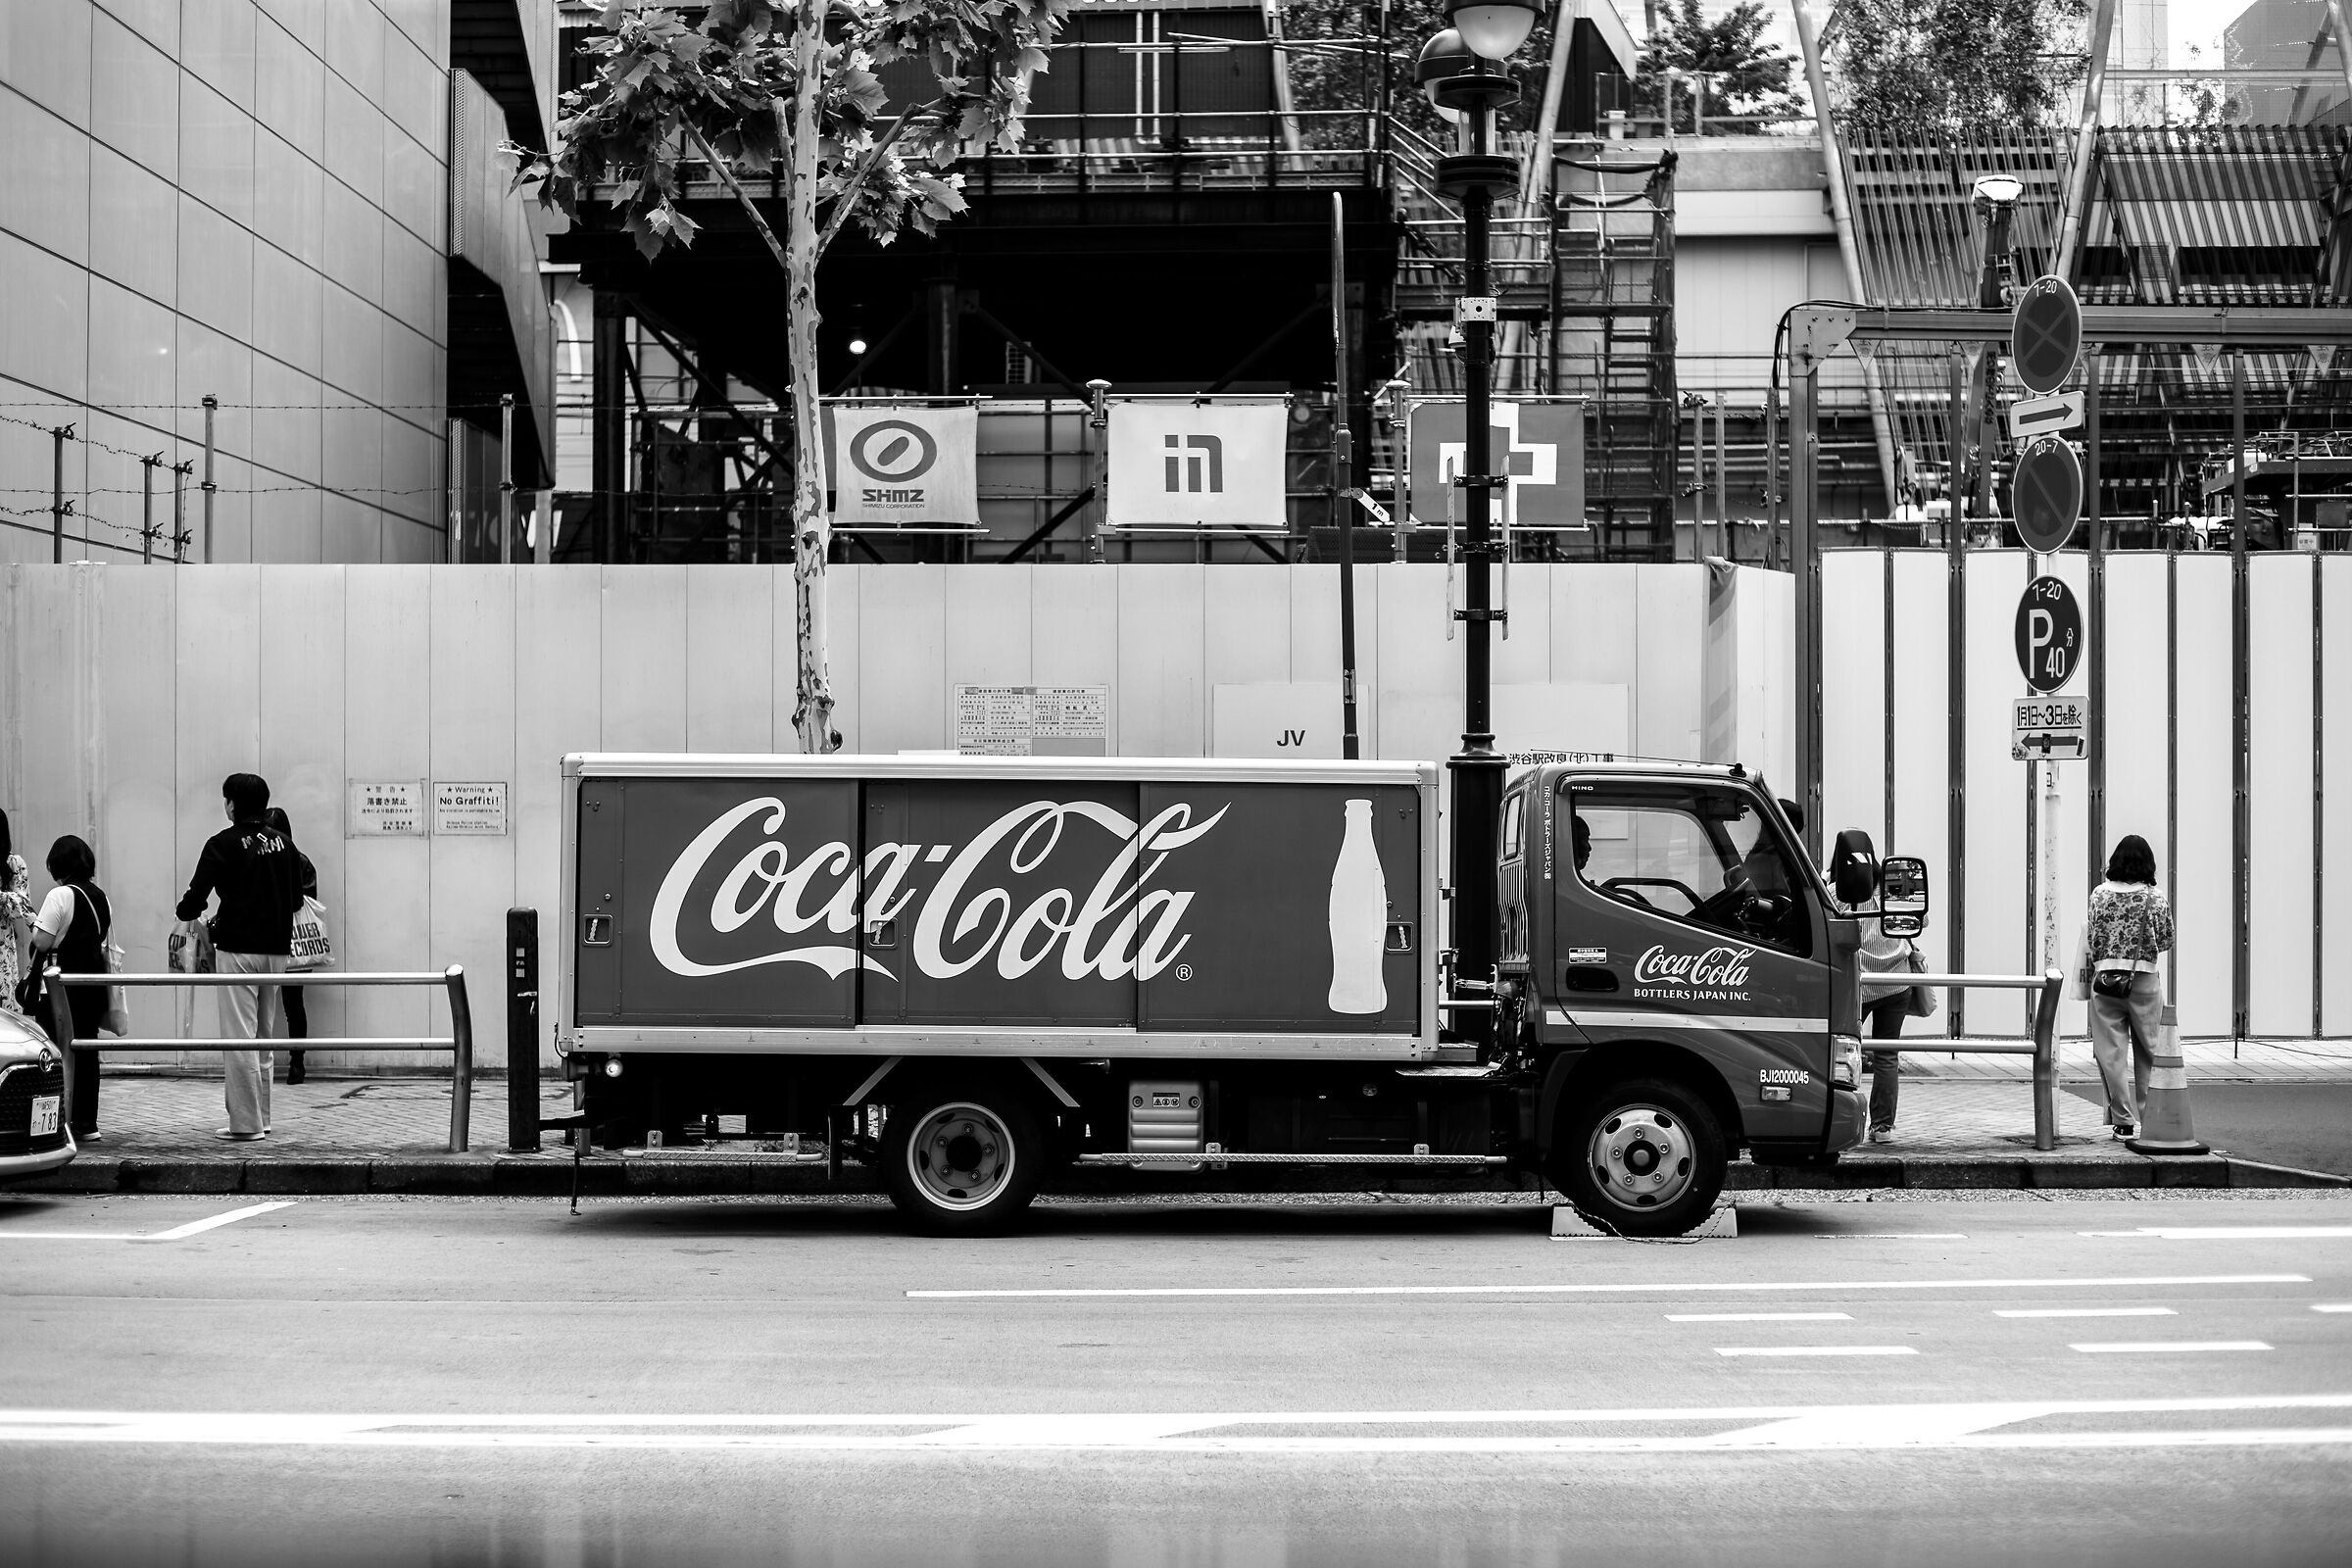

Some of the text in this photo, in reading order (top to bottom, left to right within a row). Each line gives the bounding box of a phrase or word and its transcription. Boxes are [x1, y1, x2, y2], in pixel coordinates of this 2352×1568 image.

[2034, 280, 2057, 297] 7-20
[2034, 440, 2058, 457] 20-7
[2032, 581, 2062, 601] 7-20
[2029, 609, 2054, 679] P
[2066, 627, 2075, 648] 分
[2045, 646, 2066, 678] 40
[1276, 729, 1306, 747] JV
[367, 797, 408, 806] 落書き禁止
[439, 796, 499, 806] No Graffiti!
[649, 796, 1231, 982] Coca-Cola
[292, 922, 321, 940] OWER
[290, 938, 331, 957] ECORDS
[1634, 945, 1757, 987] Coca-Cola
[1634, 988, 1751, 1002] BOTTLERS JAPAN INC.
[1760, 1069, 1810, 1085] BJI2000045
